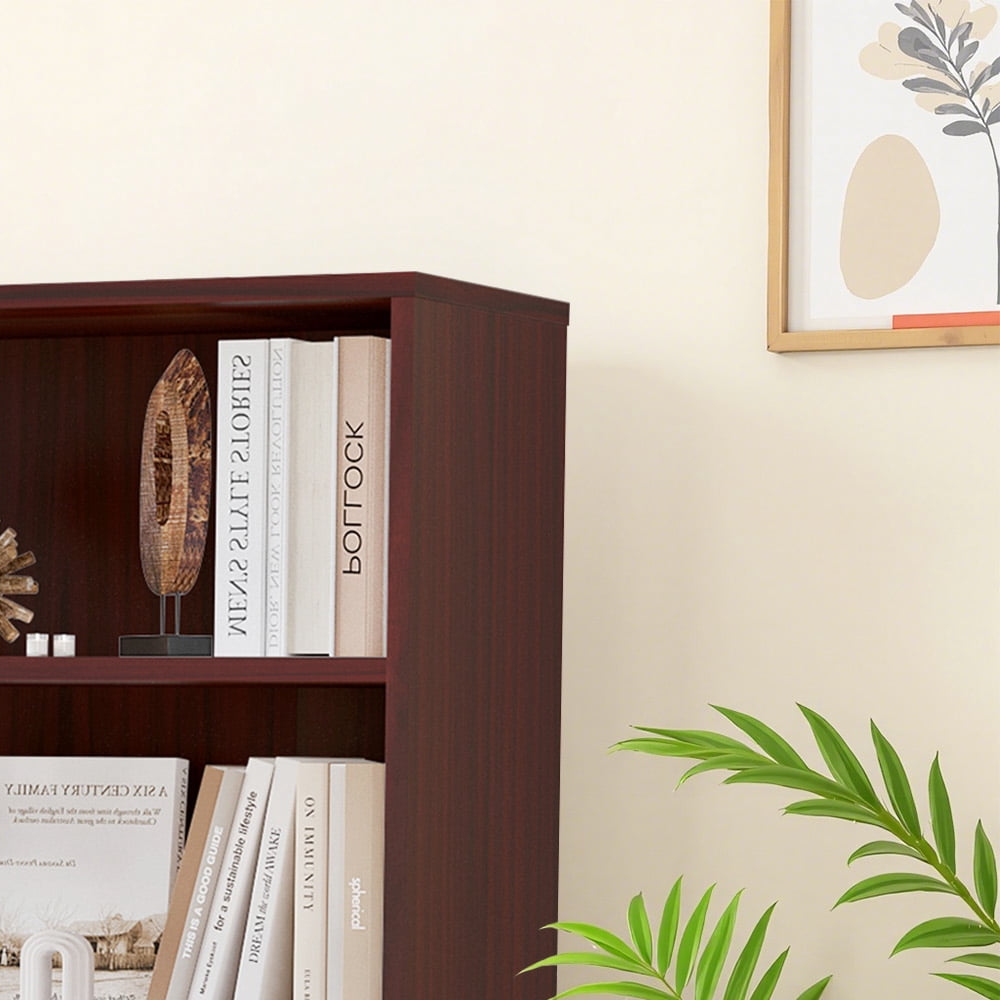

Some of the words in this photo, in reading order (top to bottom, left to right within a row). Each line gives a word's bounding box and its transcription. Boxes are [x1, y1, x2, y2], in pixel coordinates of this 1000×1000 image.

[239, 791, 258, 835] lifestyle
[304, 796, 316, 818] ON
[206, 825, 224, 864] GUIDE
[197, 867, 213, 904] GOOD
[224, 837, 246, 902] sustainable
[302, 826, 315, 912] IMMUNITY
[193, 907, 203, 917] A
[220, 904, 229, 912] a
[248, 915, 266, 964] DREAM
[265, 827, 283, 871] AWAKE
[348, 877, 366, 931] spherical
[189, 917, 201, 930] IS
[214, 917, 225, 931] for
[182, 931, 197, 960] THIS
